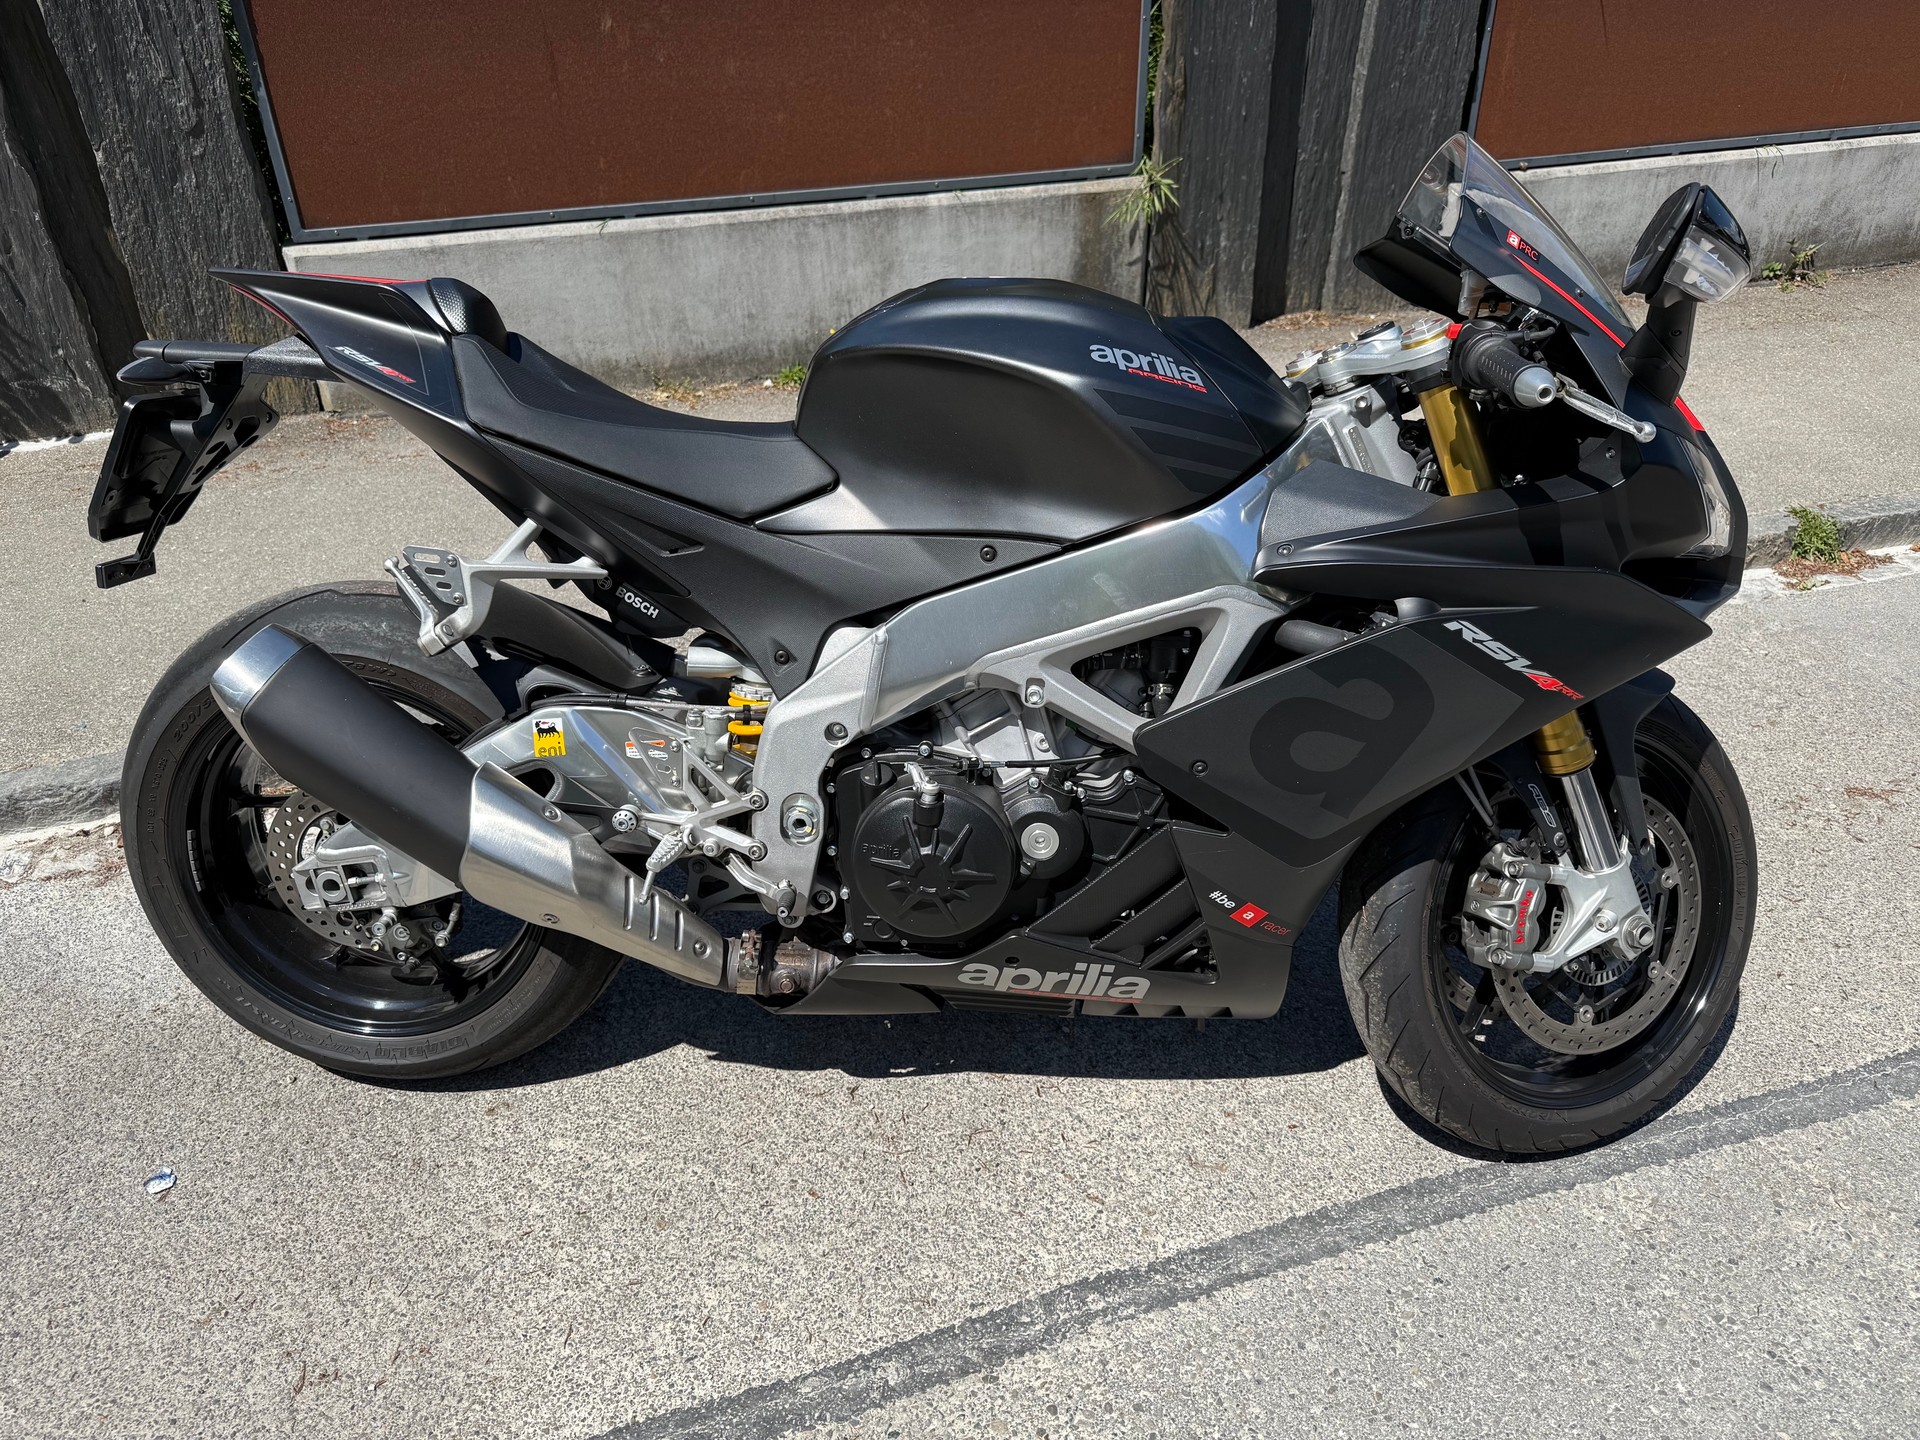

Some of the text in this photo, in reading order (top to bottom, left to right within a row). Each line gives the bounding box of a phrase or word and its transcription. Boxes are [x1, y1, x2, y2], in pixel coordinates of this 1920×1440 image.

[1089, 344, 1205, 388] aprilia
[615, 586, 660, 619] BOSCH
[538, 741, 563, 757] eni
[1527, 783, 1557, 828] ABS
[862, 843, 900, 858] aprilia
[1208, 890, 1236, 909] #be
[1260, 920, 1292, 936] racer
[1513, 889, 1534, 945] brembo
[956, 962, 1151, 1000] aprilia
